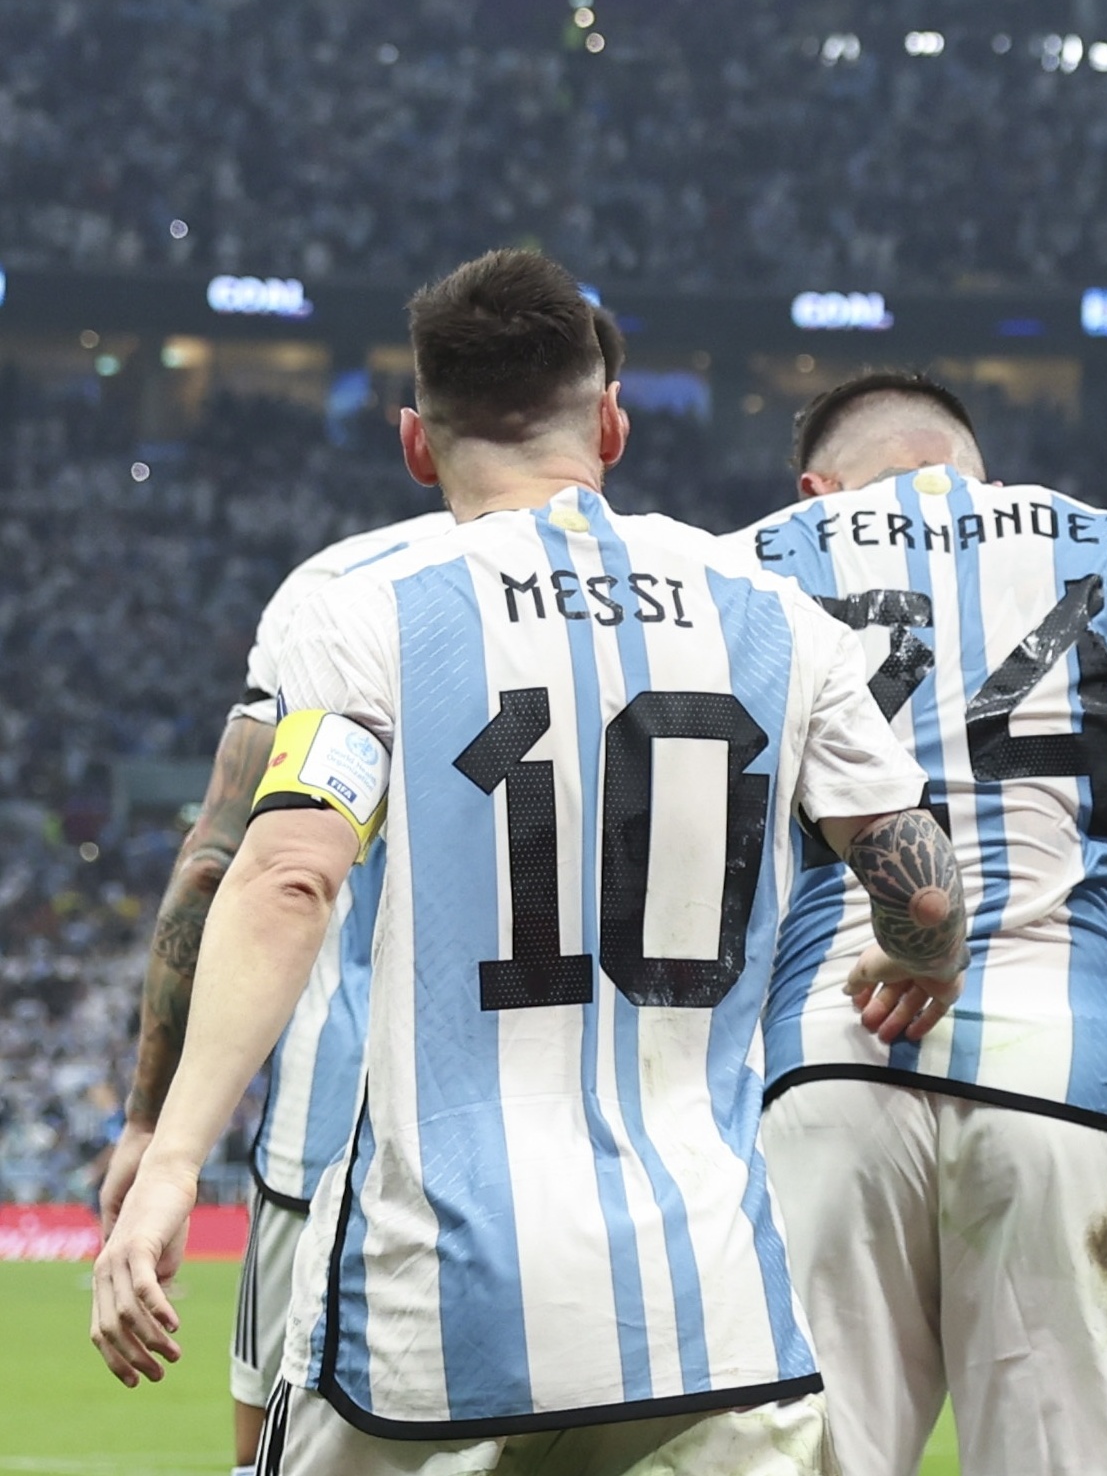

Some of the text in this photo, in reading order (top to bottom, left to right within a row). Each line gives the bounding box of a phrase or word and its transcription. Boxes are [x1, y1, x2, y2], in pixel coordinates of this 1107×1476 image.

[755, 527, 796, 562] E.
[499, 569, 694, 629] MESSI
[328, 777, 355, 802] FIFA
[451, 686, 771, 1013] 10
